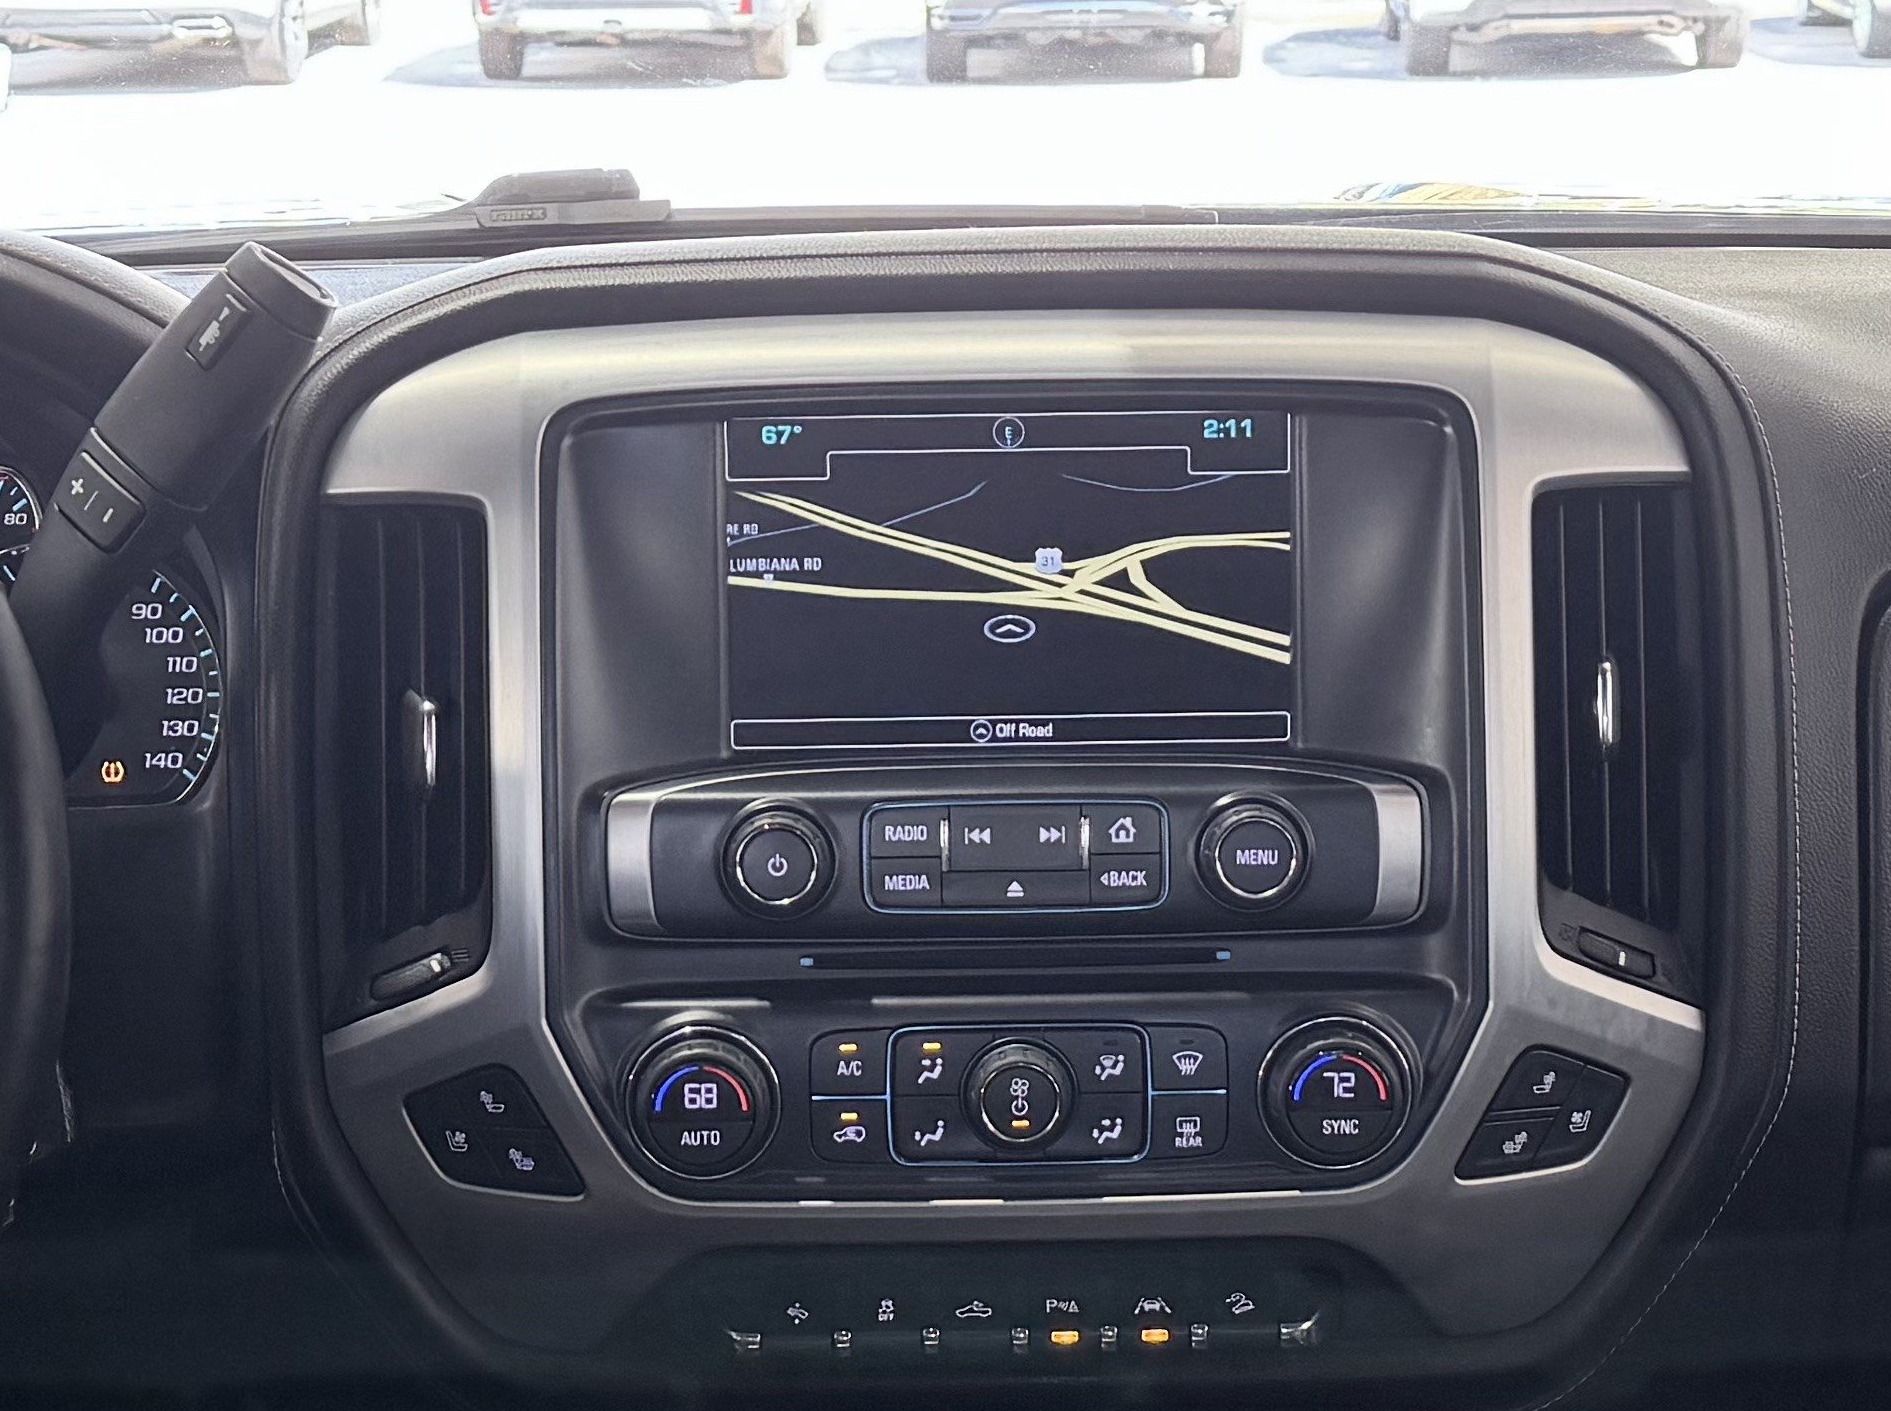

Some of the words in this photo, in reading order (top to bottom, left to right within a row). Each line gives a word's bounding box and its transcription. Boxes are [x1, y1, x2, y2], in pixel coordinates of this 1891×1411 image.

[1202, 417, 1254, 440] 2:11
[3, 512, 28, 526] 80
[729, 557, 800, 573] LUMBIANA
[803, 557, 822, 572] RD
[1041, 556, 1055, 567] 31
[131, 603, 163, 620] 90
[144, 626, 184, 644] 100
[166, 656, 198, 673] 110
[165, 688, 204, 704] 120
[161, 720, 200, 737] 130
[995, 721, 1015, 739] Off
[1016, 721, 1053, 739] Road
[144, 752, 184, 769] 140
[883, 823, 929, 845] RADIO
[1234, 847, 1280, 867] MENU
[883, 873, 931, 894] MEDIA
[1108, 867, 1149, 890] BACK
[835, 1059, 864, 1079] A/C
[1321, 1071, 1358, 1099] 72
[681, 1082, 719, 1110] 68
[1320, 1117, 1361, 1138] SYNC
[679, 1126, 722, 1148] AUTO
[1174, 1135, 1204, 1149] REAR
